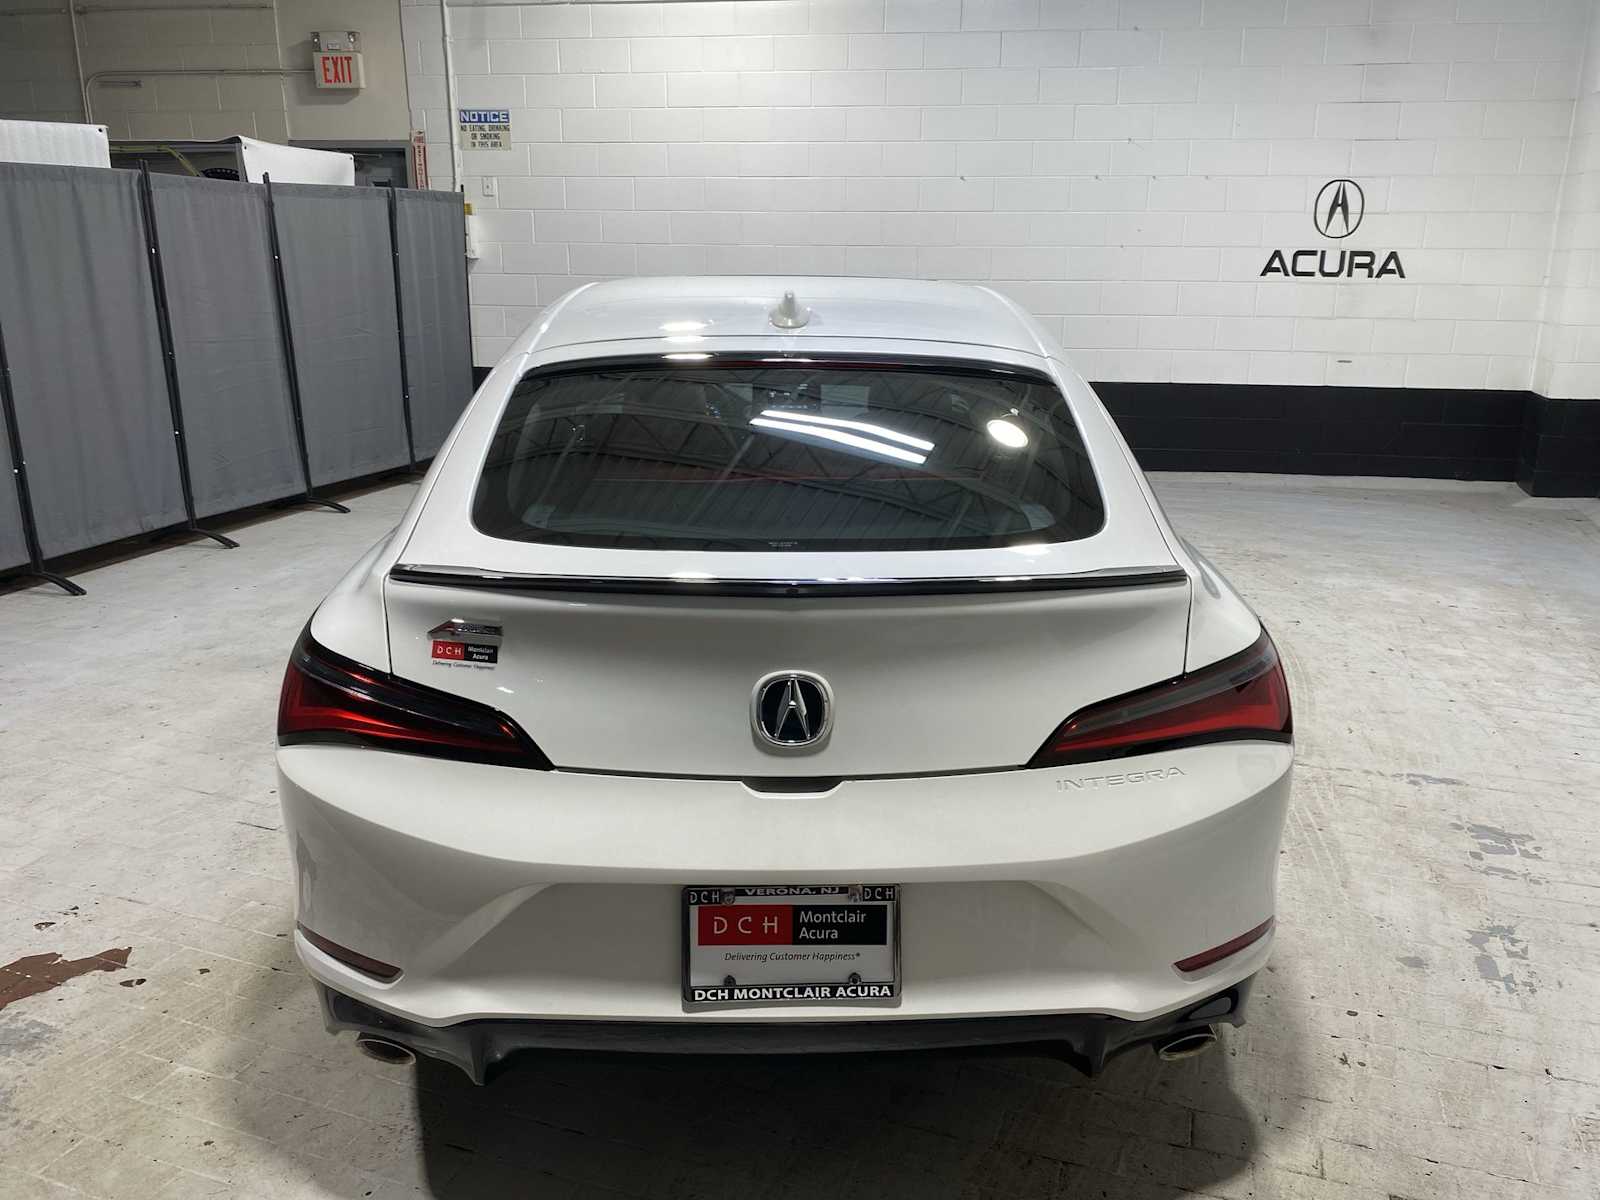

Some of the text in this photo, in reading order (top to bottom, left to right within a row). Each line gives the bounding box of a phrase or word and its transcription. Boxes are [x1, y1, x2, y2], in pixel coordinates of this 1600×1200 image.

[321, 56, 352, 83] EXIT
[460, 111, 509, 122] NOTICE
[1259, 250, 1406, 279] ACURA
[1056, 767, 1185, 792] INTEGRA
[820, 887, 840, 895] NJ
[799, 910, 867, 924] Montclair
[799, 927, 839, 940] Acura
[724, 952, 768, 963] Delivering
[769, 952, 811, 961] Customer
[694, 985, 892, 1001] DCH MONTCLAIR ACURA
